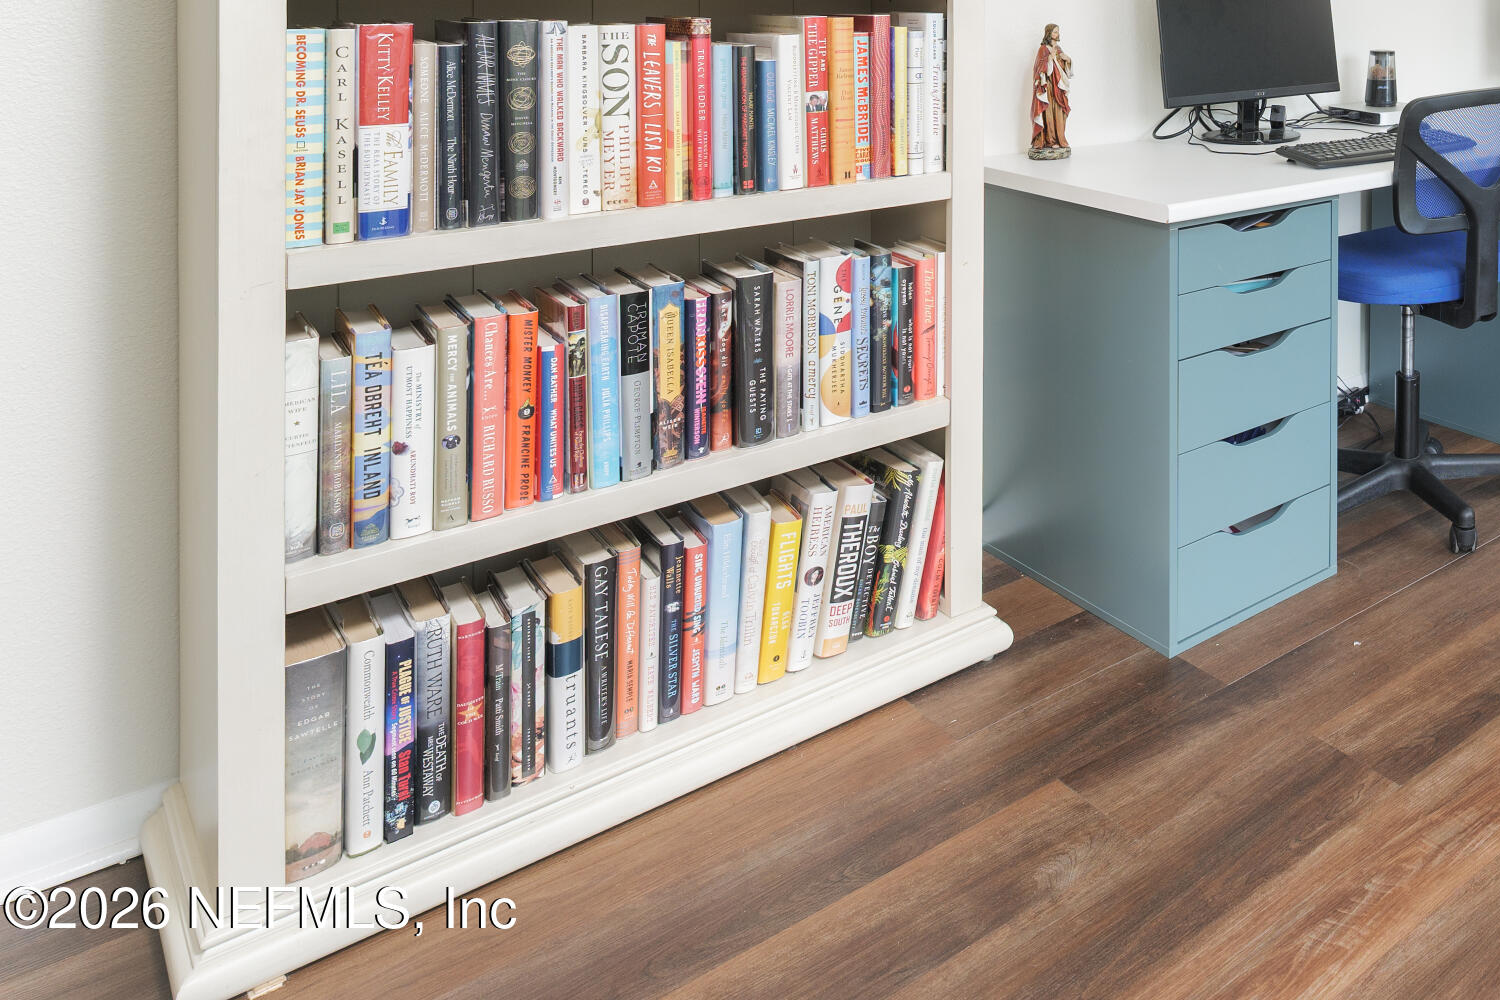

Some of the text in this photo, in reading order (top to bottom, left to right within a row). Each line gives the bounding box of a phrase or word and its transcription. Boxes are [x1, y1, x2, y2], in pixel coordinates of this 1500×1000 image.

[556, 37, 564, 50] THE
[601, 31, 629, 41] THE
[807, 23, 819, 88] THE GIPPER
[818, 38, 827, 58] TIP
[336, 46, 349, 102] CARL
[377, 33, 394, 121] KITTY KELLEY
[447, 61, 456, 122] Alice McDermott
[556, 71, 564, 89] WHO
[601, 43, 630, 120] SON
[642, 51, 662, 111] LEAVERS
[697, 49, 706, 121] TRACY KIDDER
[857, 40, 869, 143] JAMES McBRIDE
[556, 91, 564, 122] WALKED
[294, 35, 307, 240] BECOMING DR. SEUSS BRIAN JAY JONES
[336, 118, 349, 205] KASELL
[556, 123, 564, 162] BACKWARD
[603, 131, 615, 192] MEYER
[619, 125, 630, 193] PHILIPP
[644, 123, 661, 151] LISA
[646, 155, 661, 173] KO
[811, 118, 819, 165] MATTHEWS
[383, 150, 403, 205] FAMILY
[627, 304, 638, 364] CAPOTE
[636, 302, 647, 363] TRUMAN
[785, 288, 795, 359] LORRIE MOORE
[833, 286, 843, 325] GENE
[521, 319, 534, 393] MISTER MONKEY
[753, 323, 762, 353] WATERS
[805, 270, 818, 400] TONI MORRISON a mercy
[447, 334, 457, 432] MERCY ANIMALS
[856, 337, 869, 391] SECRETS
[331, 370, 348, 416] LILA
[481, 322, 497, 513] Chances RICHARD RUSSO
[749, 379, 757, 414] GUESTS
[759, 386, 767, 421] PAYING
[363, 352, 388, 500] TÉA OBREHT INLAND
[520, 425, 531, 501] FRANCINE PROSE
[808, 506, 822, 559] HEIRESS
[844, 504, 868, 514] PAUL
[776, 532, 797, 590] FLIGHTS
[833, 520, 863, 600] THEROUX
[594, 565, 609, 662] GAY TALESE
[829, 602, 852, 617] DEEP
[362, 650, 375, 721] Commonwealth
[398, 659, 412, 697] PLAGUE
[426, 625, 444, 720] RUTH WARE
[667, 633, 679, 699] SILVER STAR
[691, 649, 704, 703] JESMYN WARD
[398, 705, 413, 745] JUSTICE
[397, 749, 411, 775] Stan
[422, 746, 434, 797] WESTAWAY
[435, 735, 447, 773] DEATH
